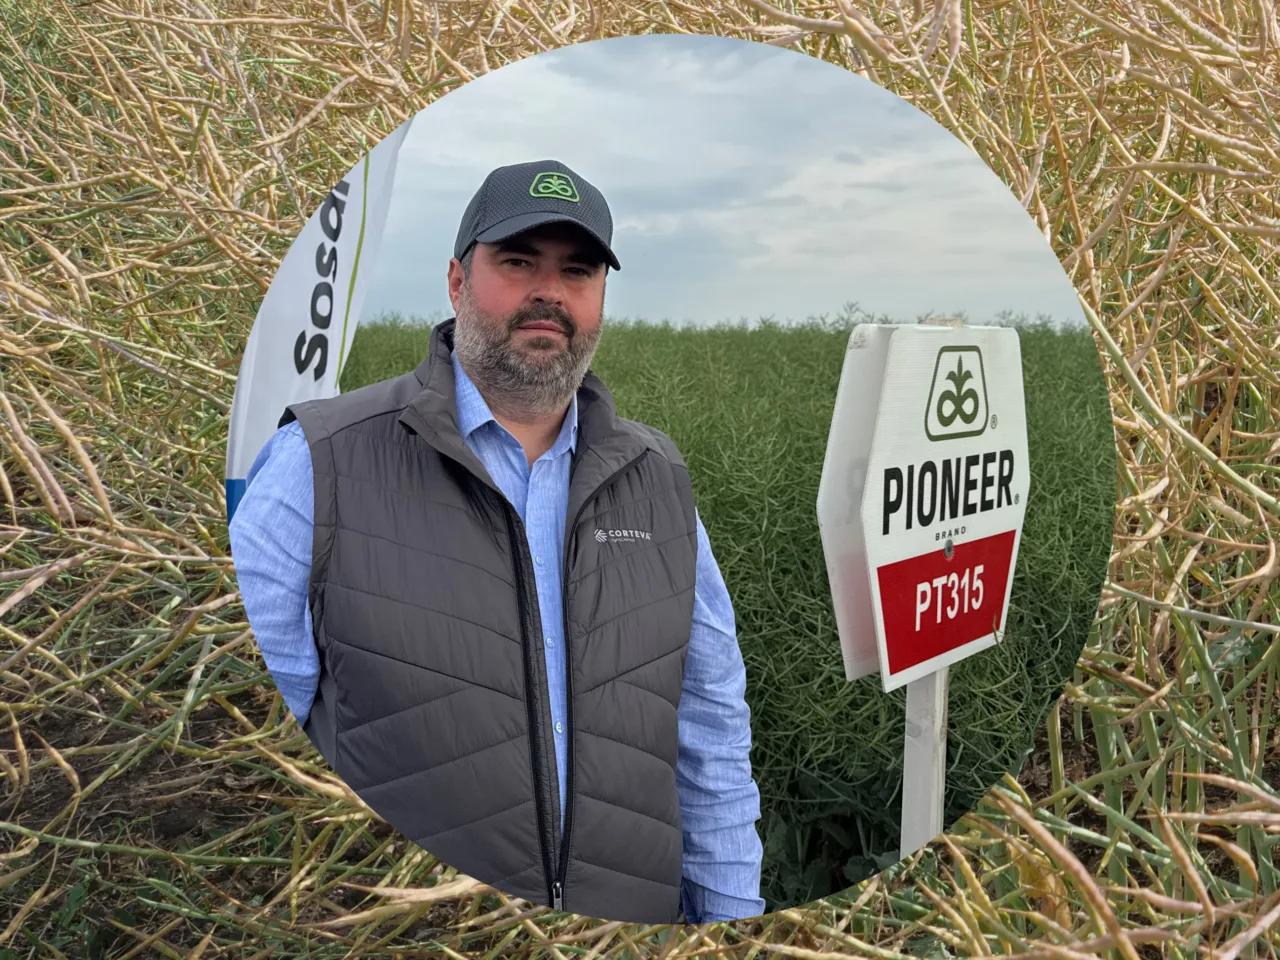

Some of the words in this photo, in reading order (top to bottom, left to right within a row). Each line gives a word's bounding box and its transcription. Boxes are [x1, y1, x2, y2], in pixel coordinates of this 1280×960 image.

[294, 181, 350, 382] Sosa
[882, 449, 1015, 536] PIONEER
[935, 526, 967, 541] BRAND
[915, 564, 984, 632] PT315
